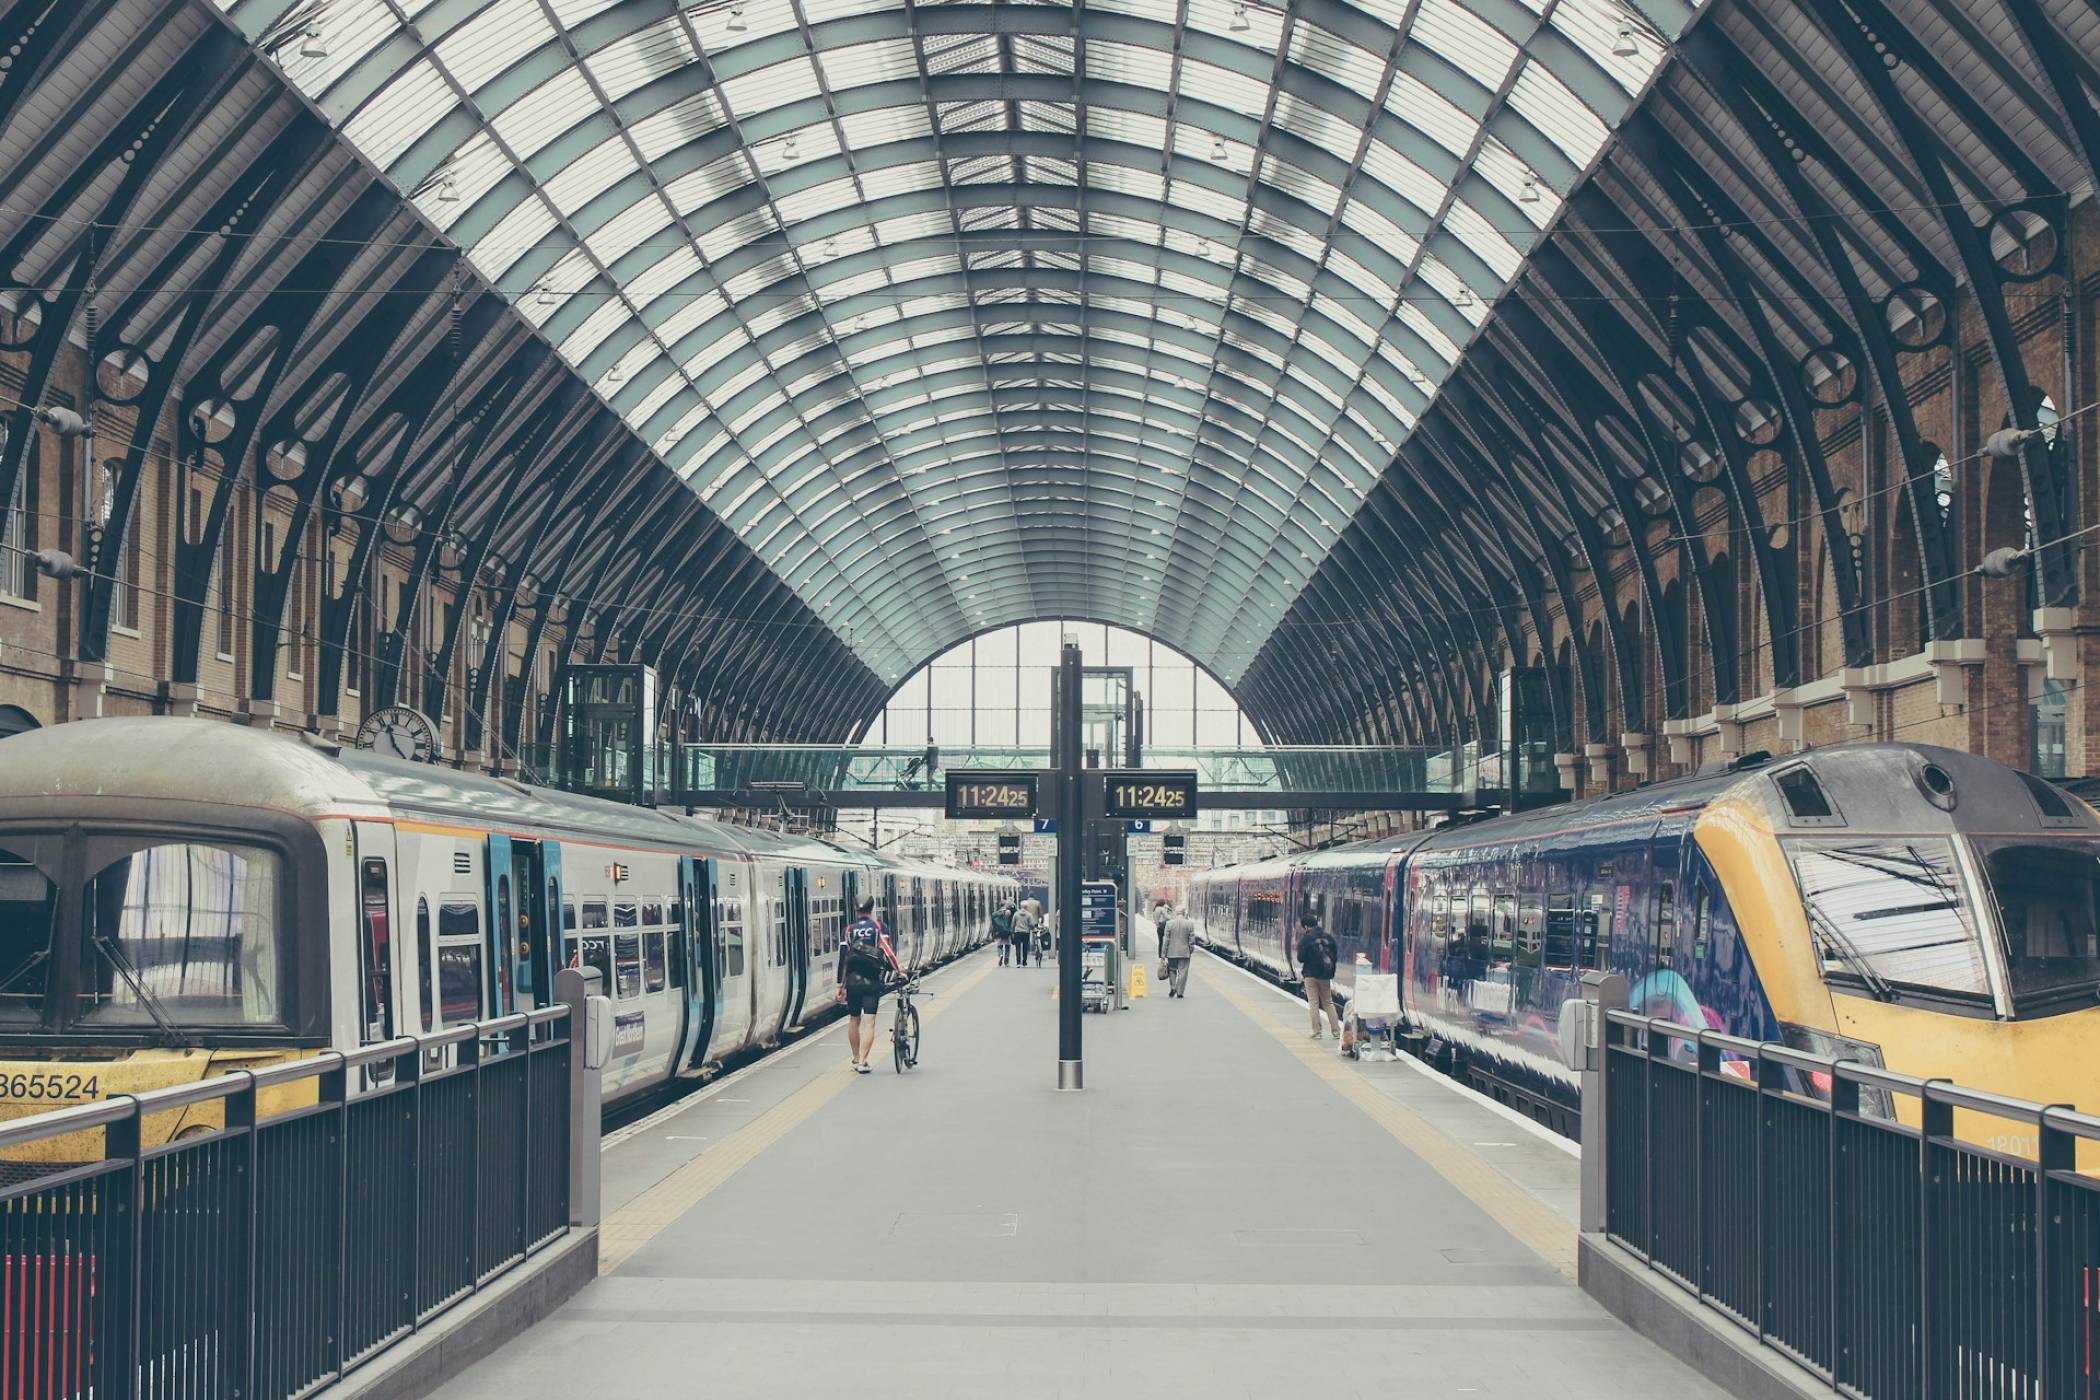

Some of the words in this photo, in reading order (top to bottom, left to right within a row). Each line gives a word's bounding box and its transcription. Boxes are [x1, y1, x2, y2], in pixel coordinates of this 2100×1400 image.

[959, 785, 1009, 807] 11:24
[1116, 785, 1167, 807] 11:24
[1039, 818, 1049, 829] 7
[1134, 819, 1144, 829] 6
